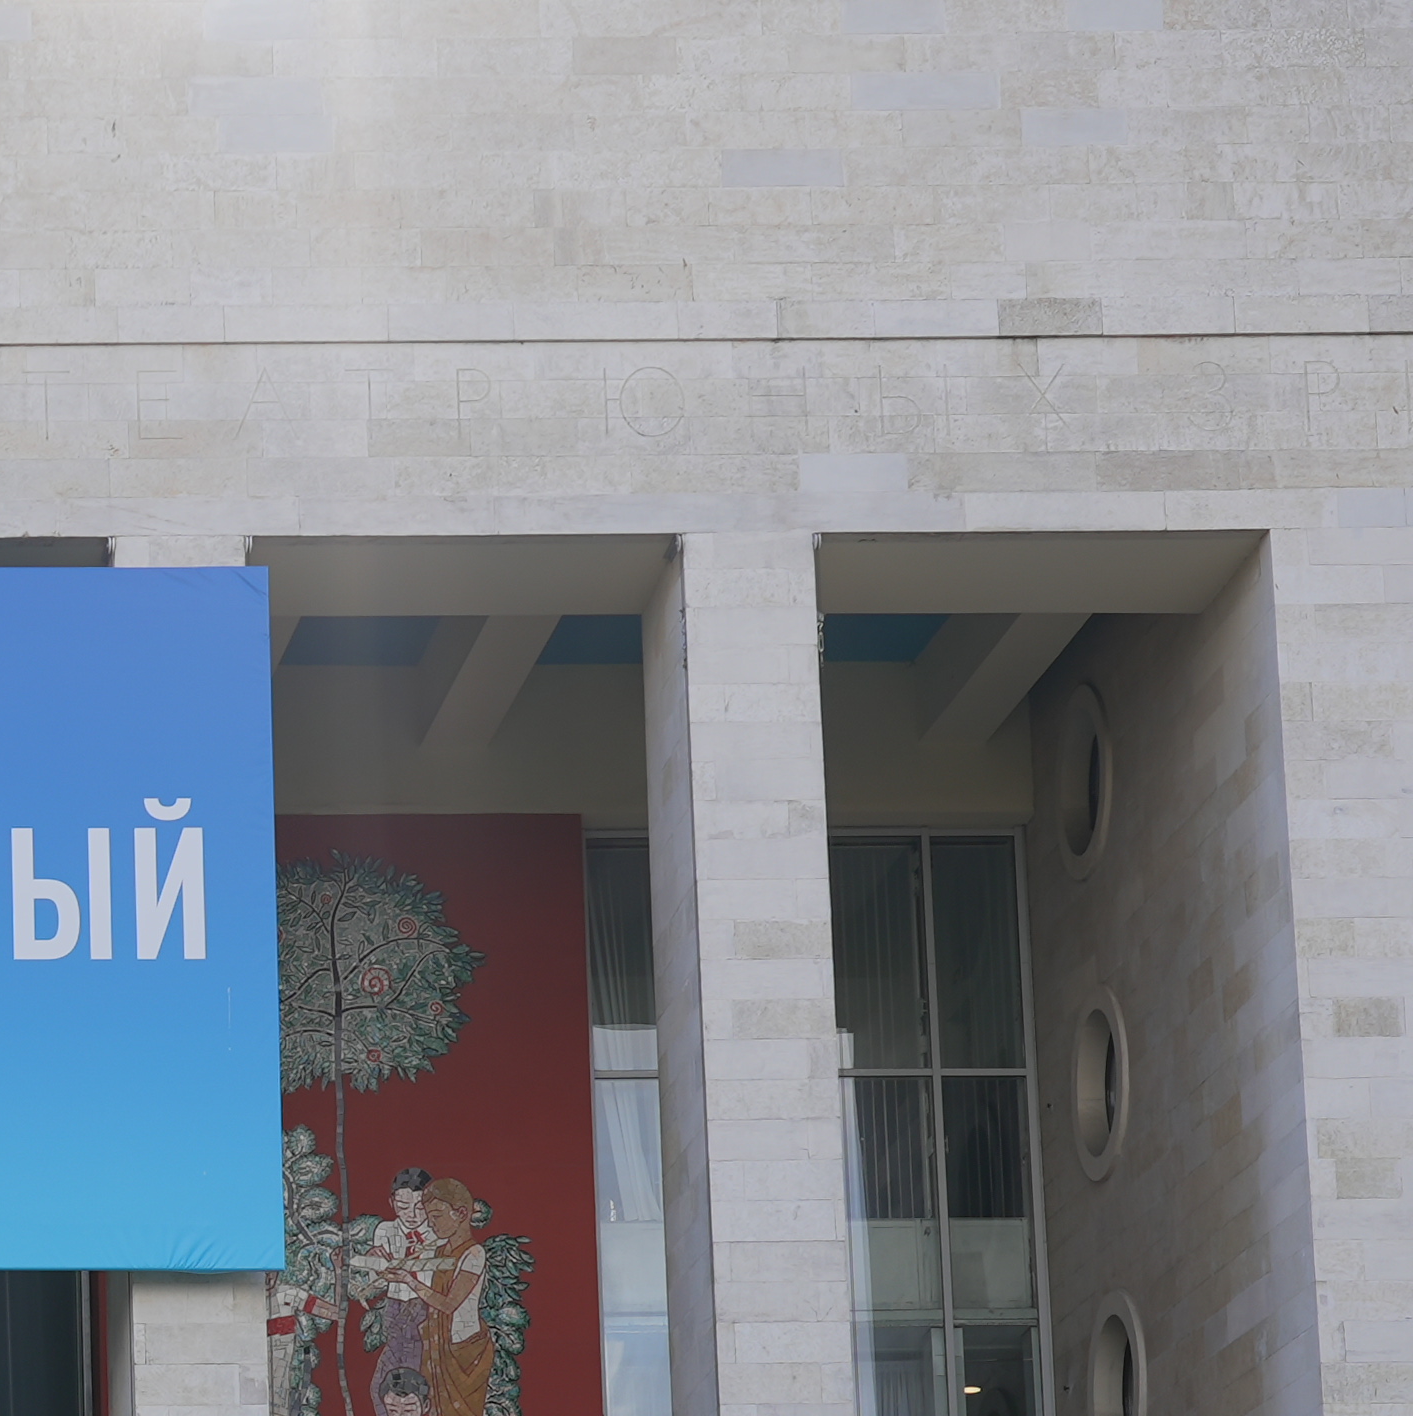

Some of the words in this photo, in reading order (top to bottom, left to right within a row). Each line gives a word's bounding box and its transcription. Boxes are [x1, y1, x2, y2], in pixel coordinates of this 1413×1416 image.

[23, 366, 491, 441] ТЕАТР
[603, 361, 1069, 438] ЮНЫХ
[1188, 358, 1413, 438] ЗР
